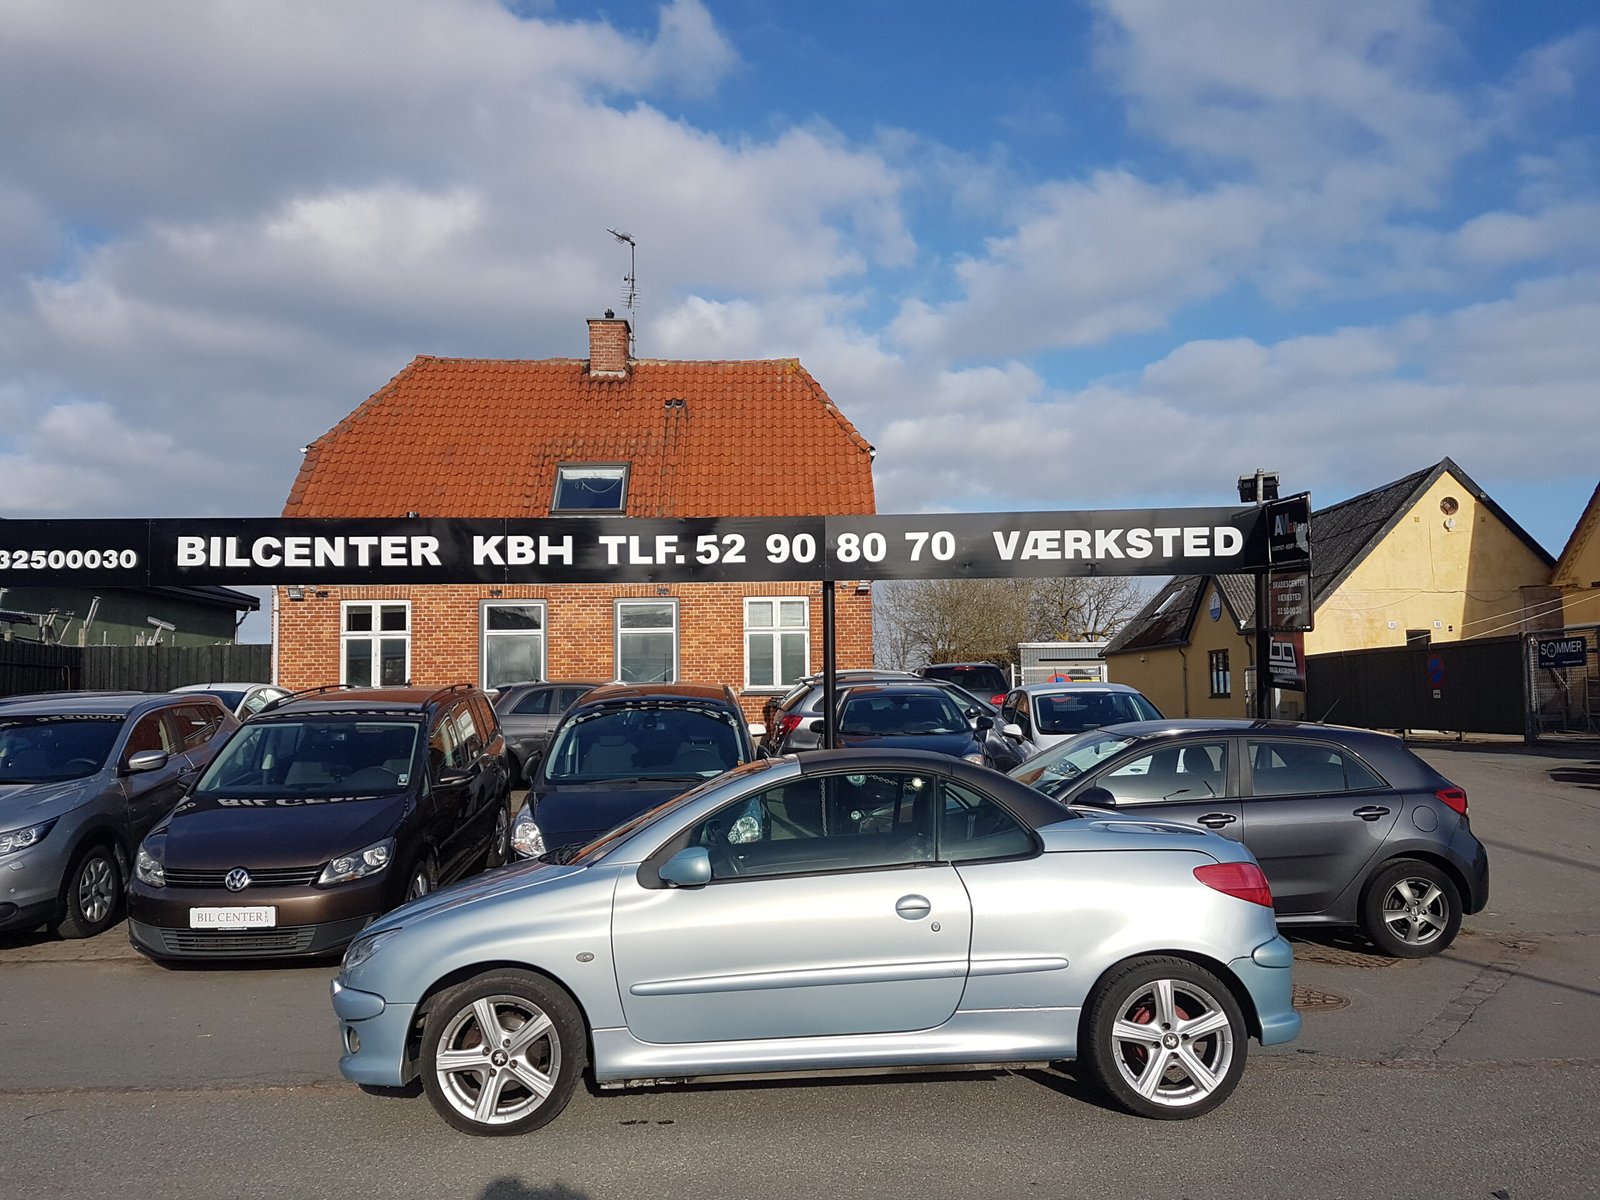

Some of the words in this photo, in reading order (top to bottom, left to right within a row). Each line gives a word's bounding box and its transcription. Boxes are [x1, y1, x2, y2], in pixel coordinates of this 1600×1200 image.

[177, 535, 442, 567] BILCENTER
[473, 535, 573, 566] KBH
[598, 535, 685, 565] TLF.
[695, 534, 746, 565] 52
[765, 533, 816, 564] 90
[836, 532, 887, 563] 80
[904, 531, 956, 562] 70
[992, 526, 1243, 562] VÆRKSTED
[0, 549, 137, 569] 32500030
[1540, 641, 1582, 658] SOMMER
[197, 913, 215, 923] BIL
[217, 911, 263, 923] CENTER
